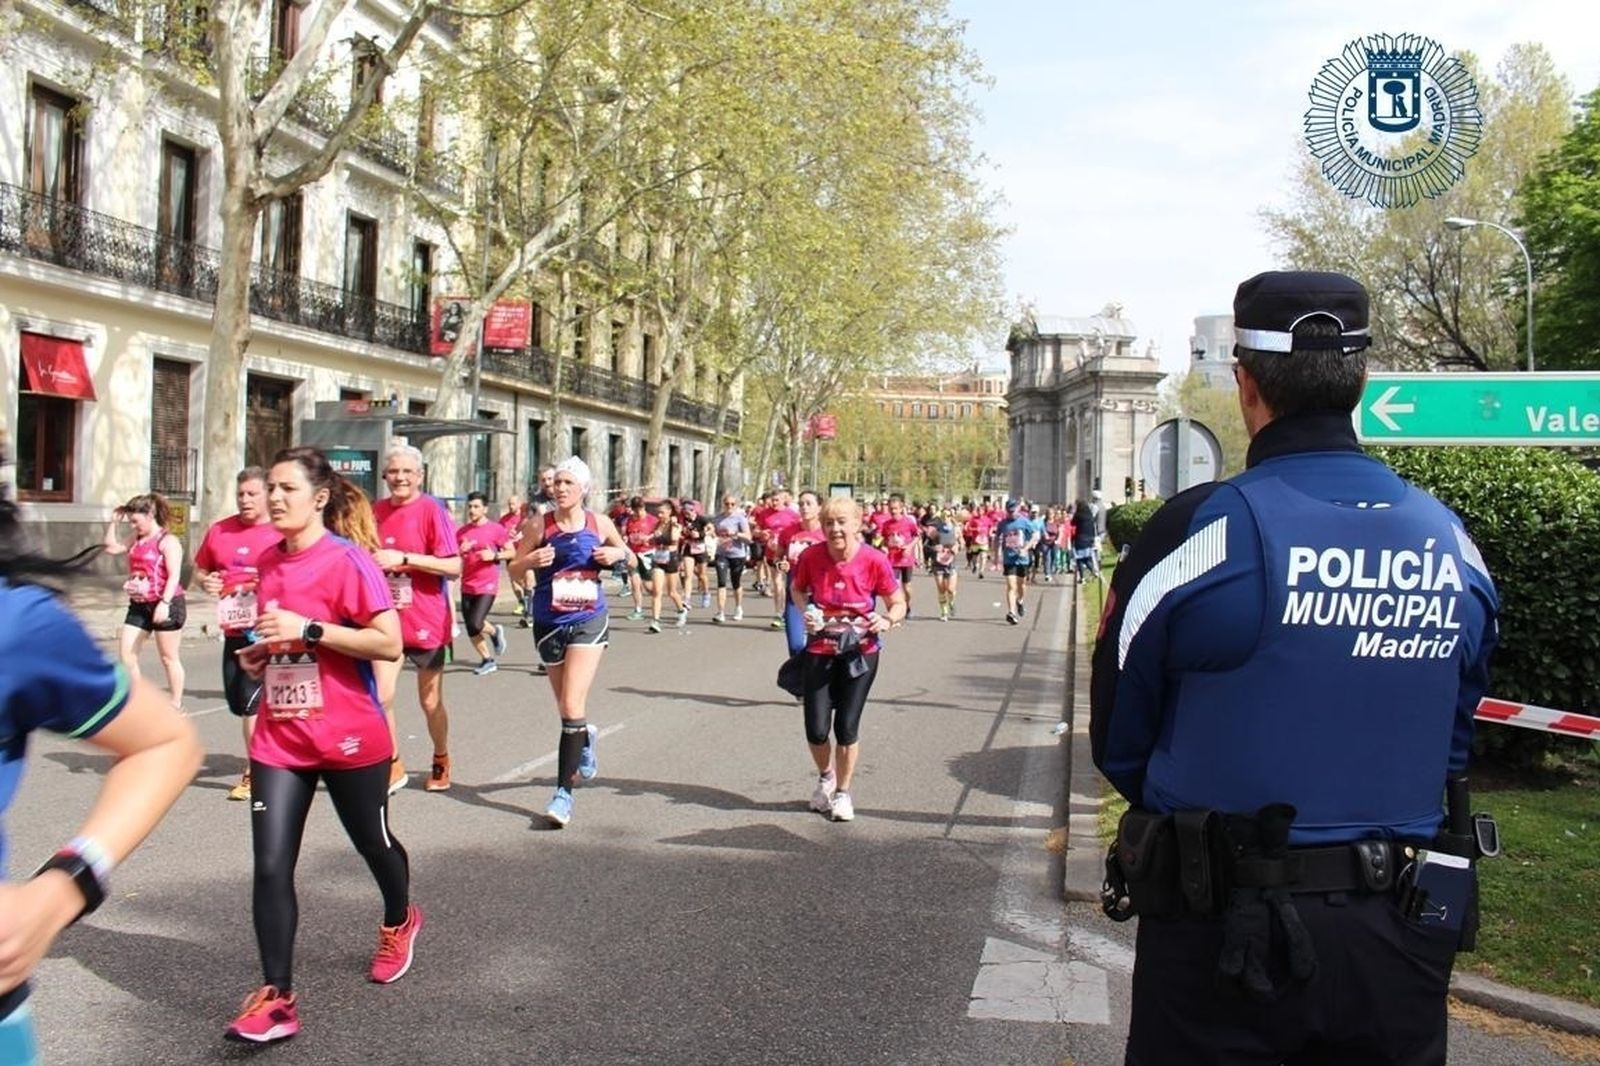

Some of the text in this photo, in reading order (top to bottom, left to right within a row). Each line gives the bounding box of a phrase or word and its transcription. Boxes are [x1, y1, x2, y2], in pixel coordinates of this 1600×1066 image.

[1525, 406, 1600, 433] Vale
[1286, 538, 1463, 592] POLICÍA
[1281, 591, 1461, 629] MUNICIPAL
[1351, 631, 1459, 659] Madrid
